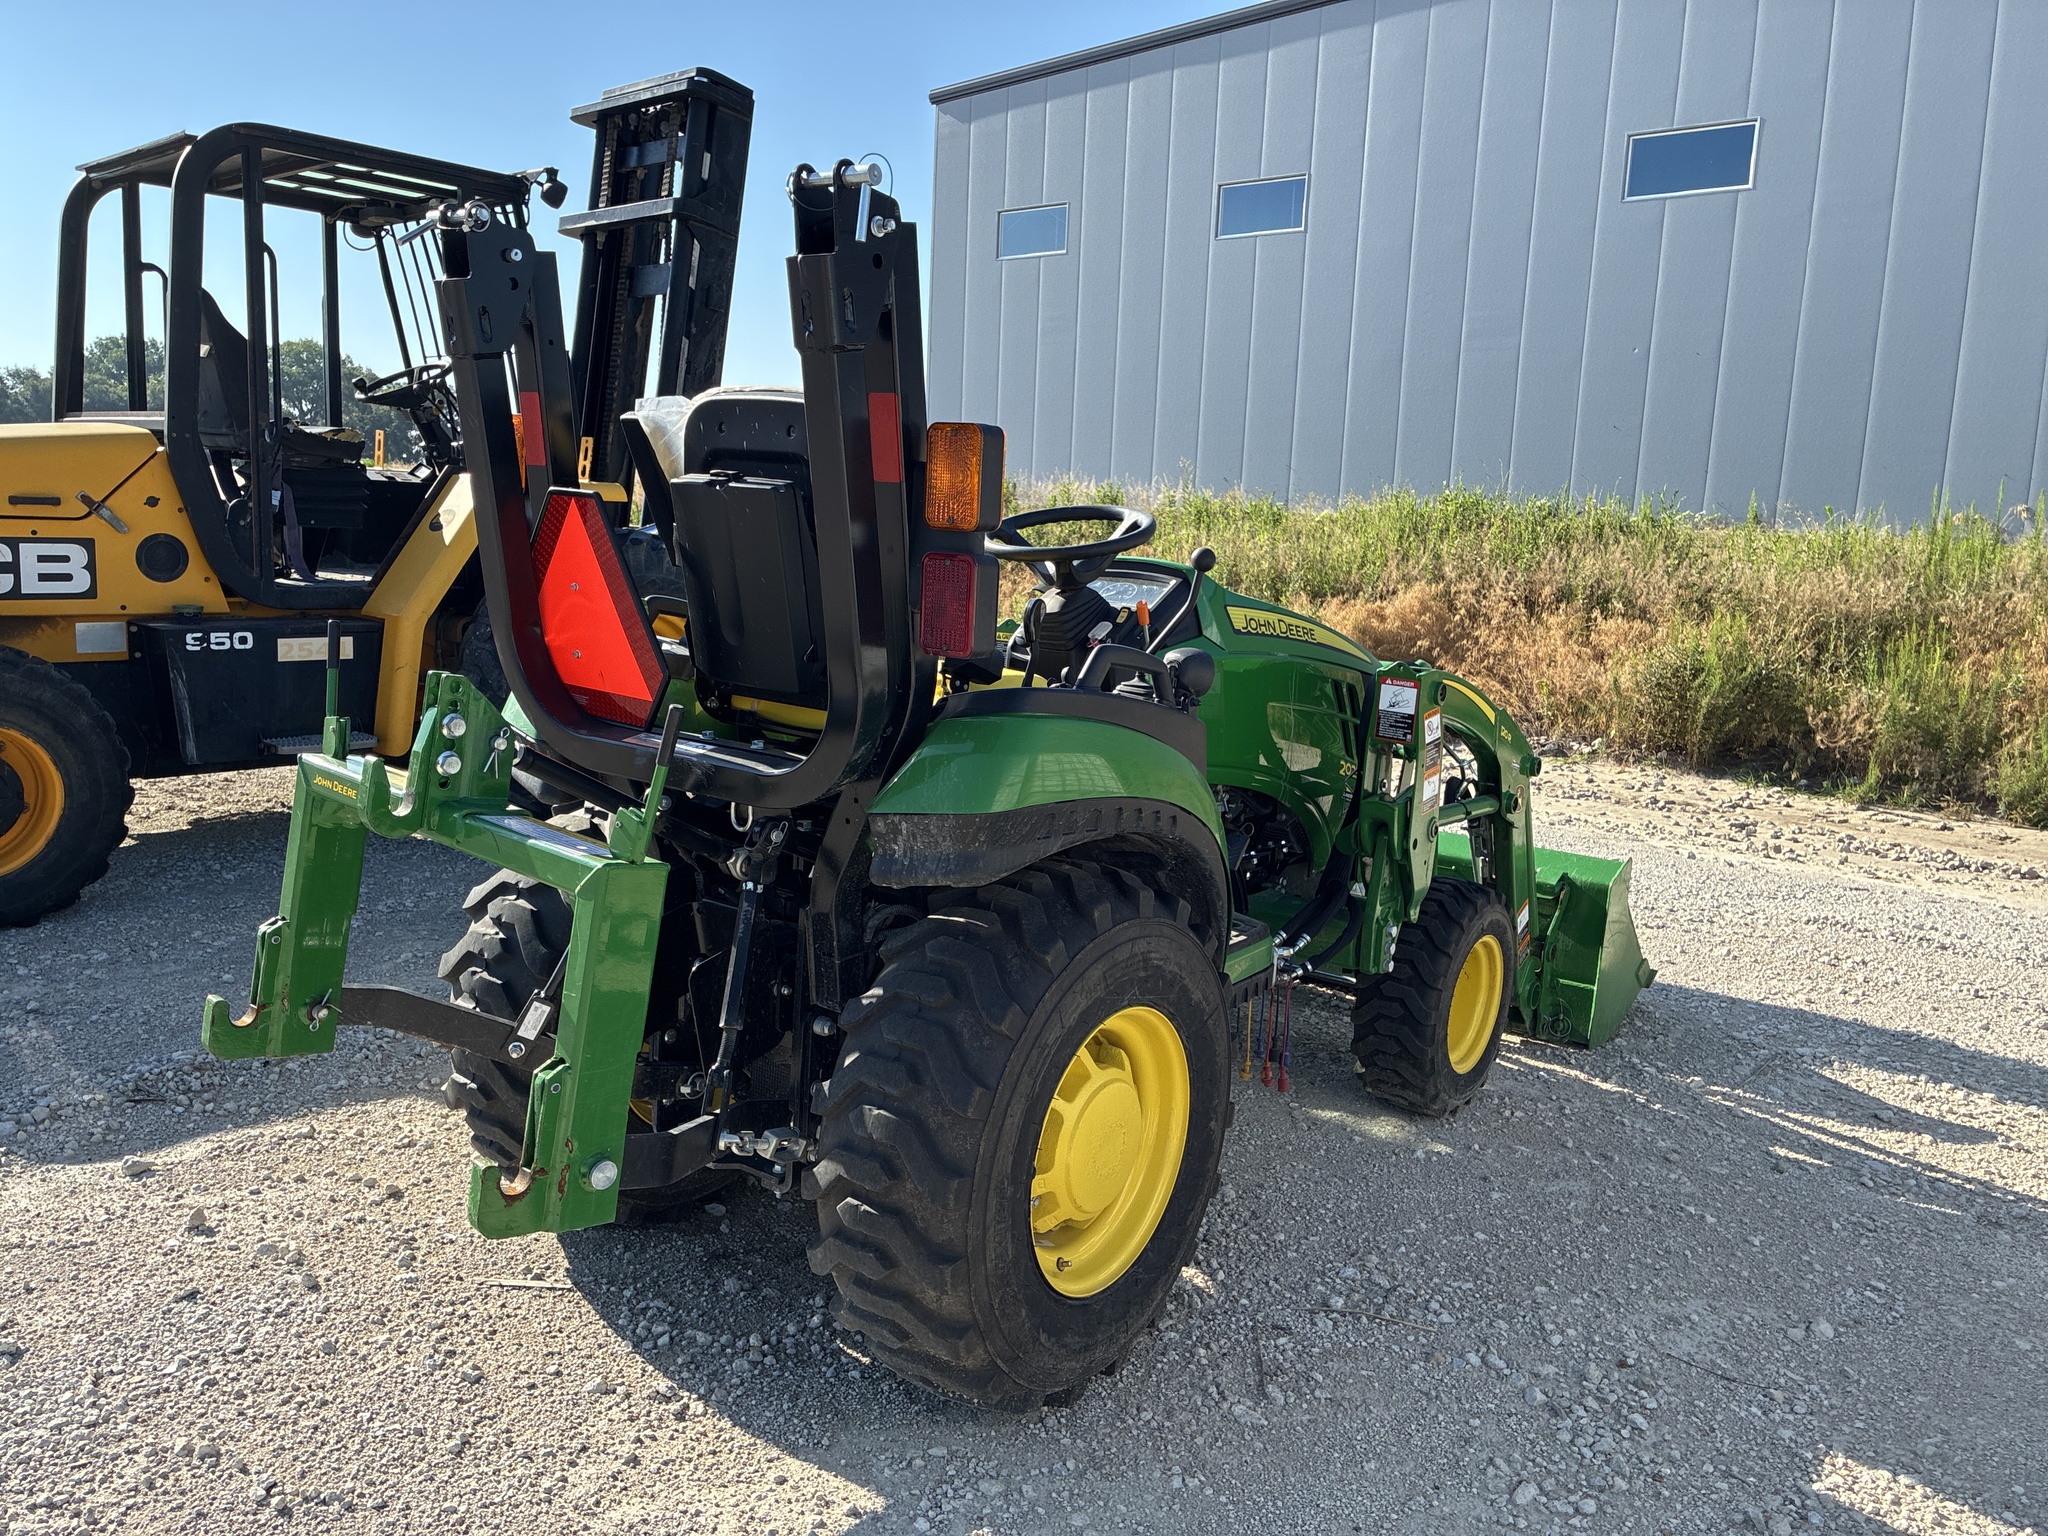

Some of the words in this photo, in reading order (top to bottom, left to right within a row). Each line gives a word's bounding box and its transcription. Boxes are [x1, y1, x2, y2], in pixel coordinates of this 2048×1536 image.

[1241, 613, 1277, 633] JOHN
[1277, 618, 1317, 641] DEERE
[1392, 679, 1415, 687] DANGER
[313, 773, 333, 790] JOHN
[333, 780, 358, 800] DEERE
